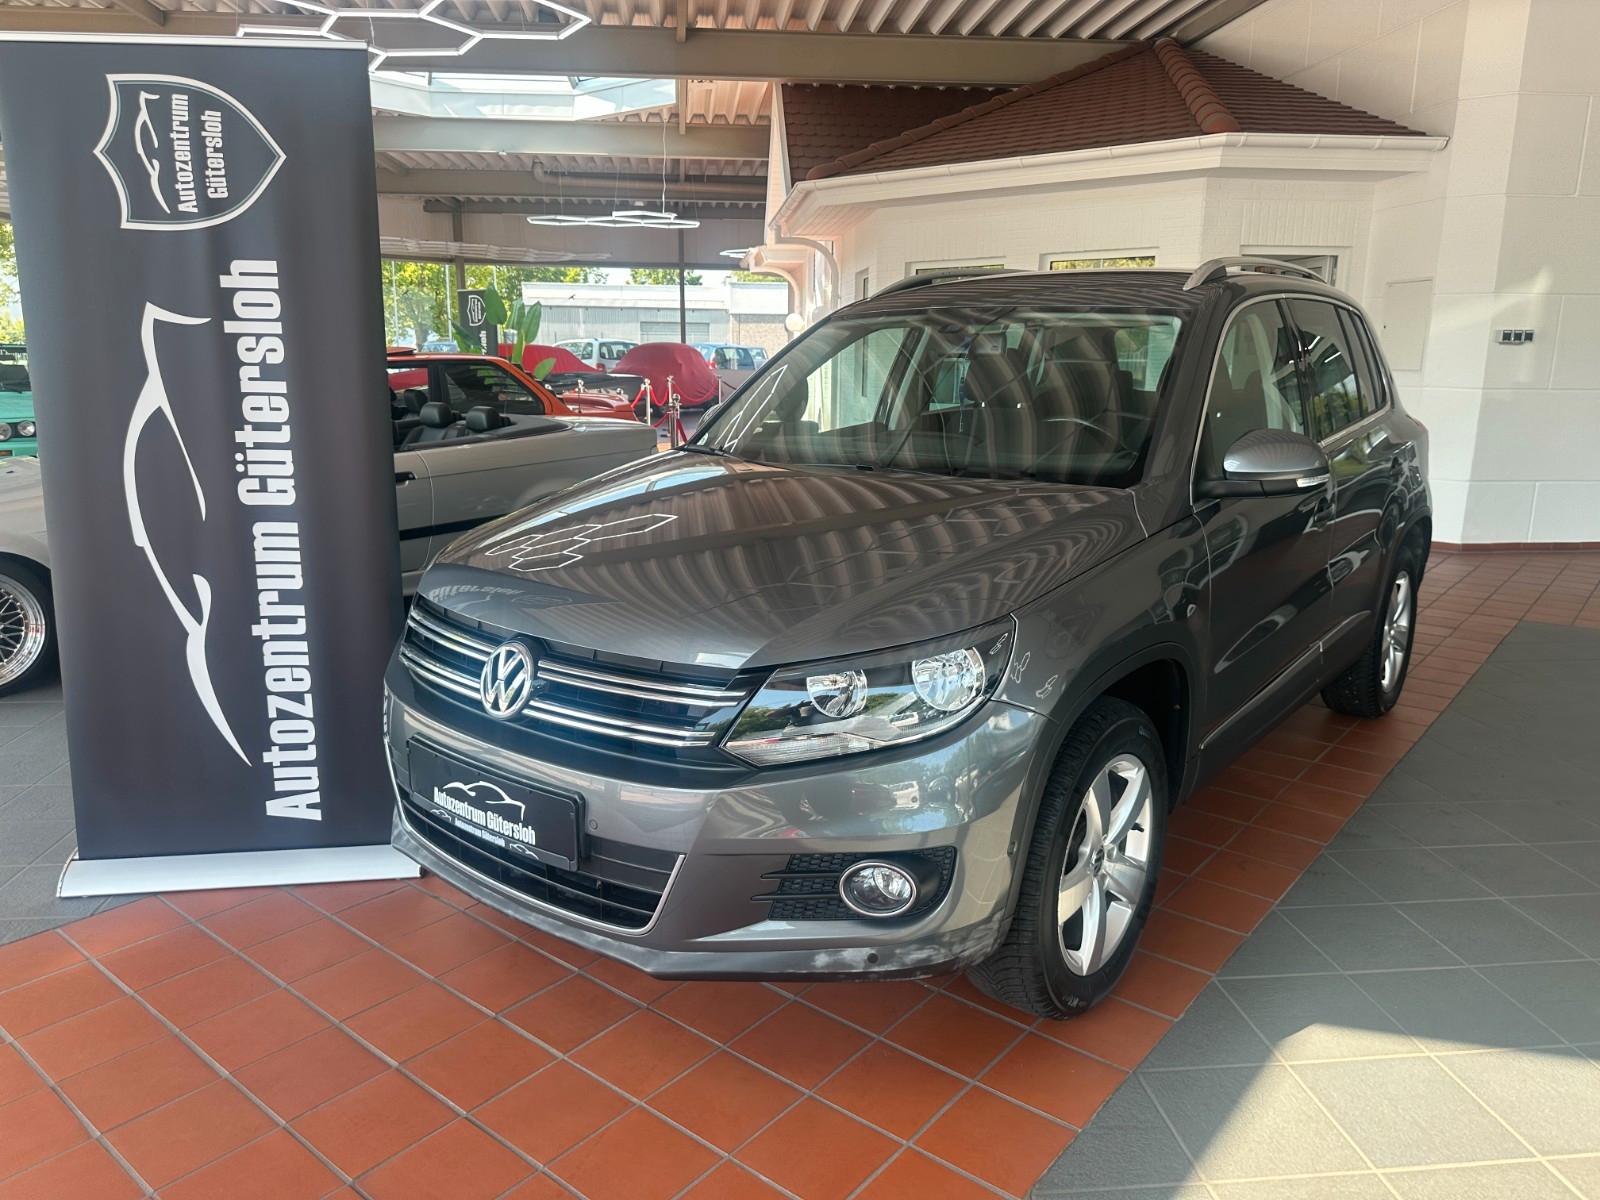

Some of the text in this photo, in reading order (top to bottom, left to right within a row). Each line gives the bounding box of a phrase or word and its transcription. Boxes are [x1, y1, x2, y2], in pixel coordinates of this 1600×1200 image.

[169, 92, 199, 214] Autozentrum
[201, 109, 229, 200] Gütersloh
[219, 259, 322, 821] Autozentrum Gütersloh
[481, 643, 532, 718] VW
[433, 786, 487, 827] Autozentrum
[486, 810, 536, 846] Gütersloh
